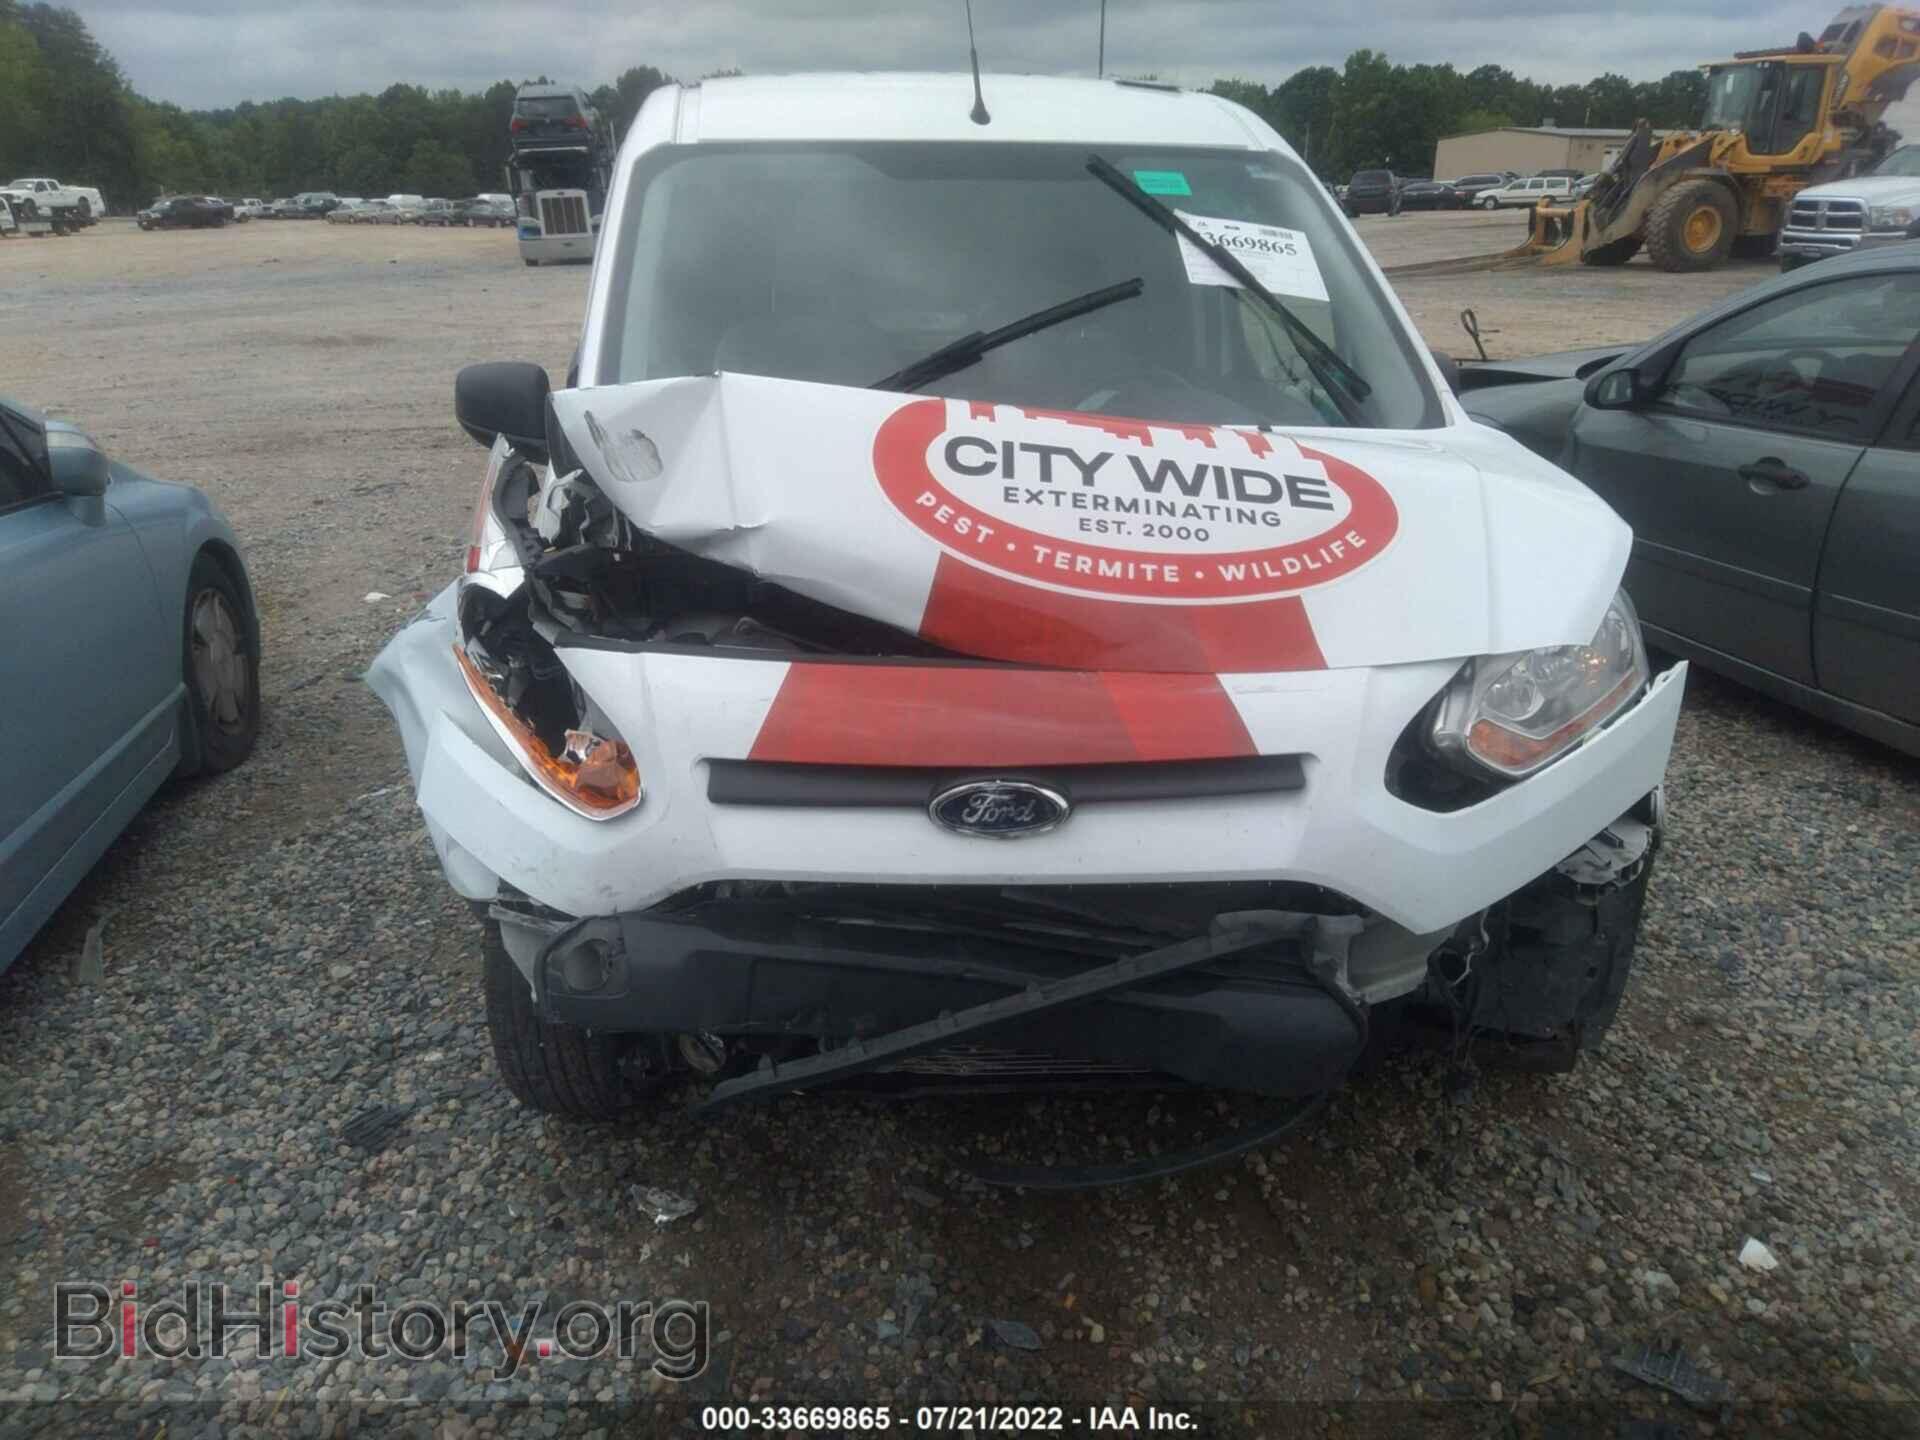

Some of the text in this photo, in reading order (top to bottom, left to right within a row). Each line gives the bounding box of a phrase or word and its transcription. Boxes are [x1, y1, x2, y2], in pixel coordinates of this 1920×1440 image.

[1199, 231, 1297, 256] 3669865
[944, 435, 1335, 511] CITY WIDE
[1003, 486, 1282, 528] EXTERMINATING
[915, 490, 1368, 582] PEST TERMITE WILDLIFE
[1079, 517, 1211, 543] EST. 2000
[960, 793, 1036, 823] Ford
